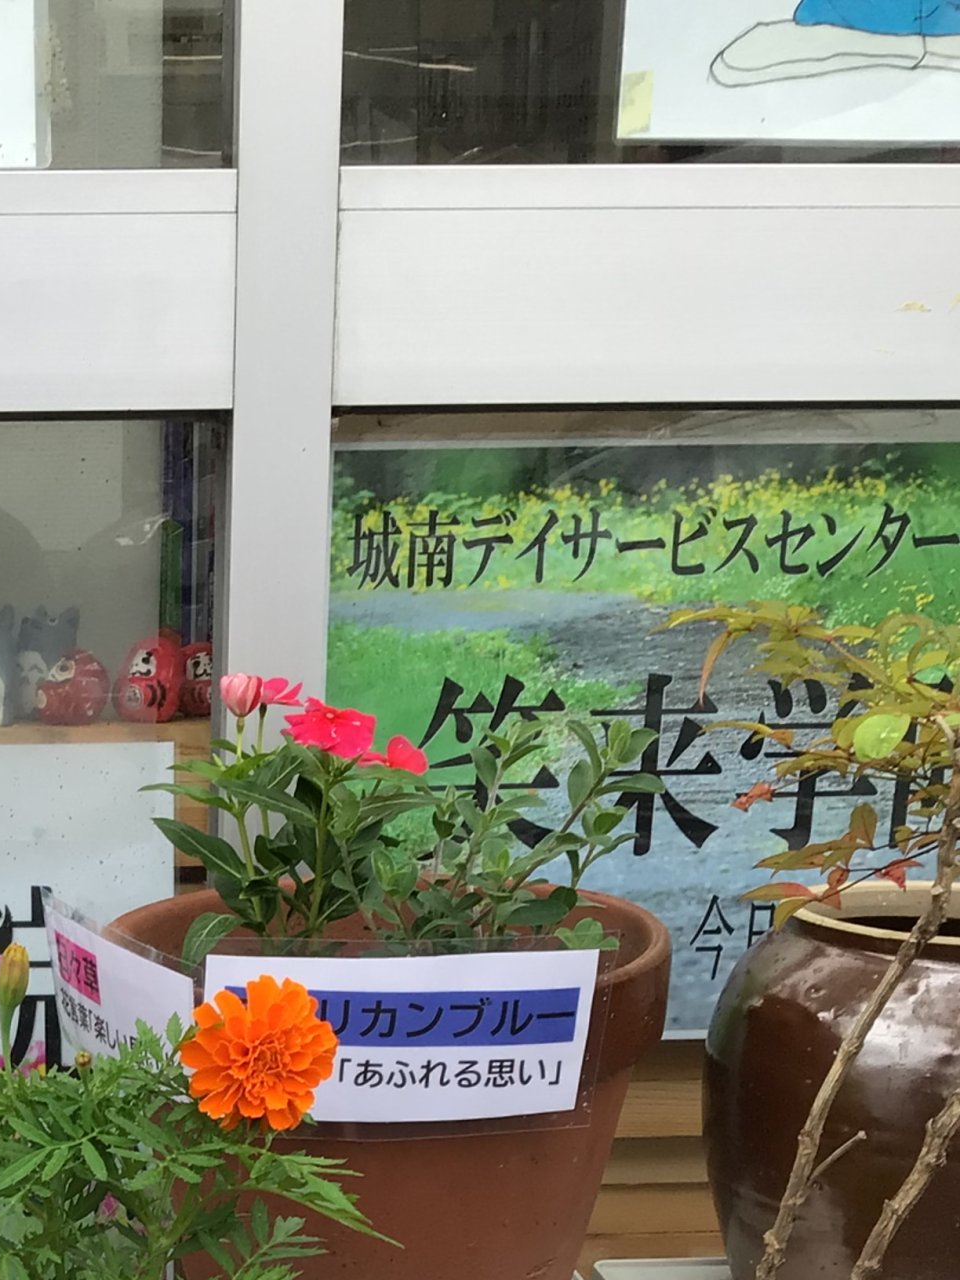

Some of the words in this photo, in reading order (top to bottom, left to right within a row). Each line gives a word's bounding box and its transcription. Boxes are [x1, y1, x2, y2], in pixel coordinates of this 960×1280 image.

[347, 503, 960, 590] 城南デイサービスセンター
[339, 1057, 562, 1089] 「あふれる思い」
